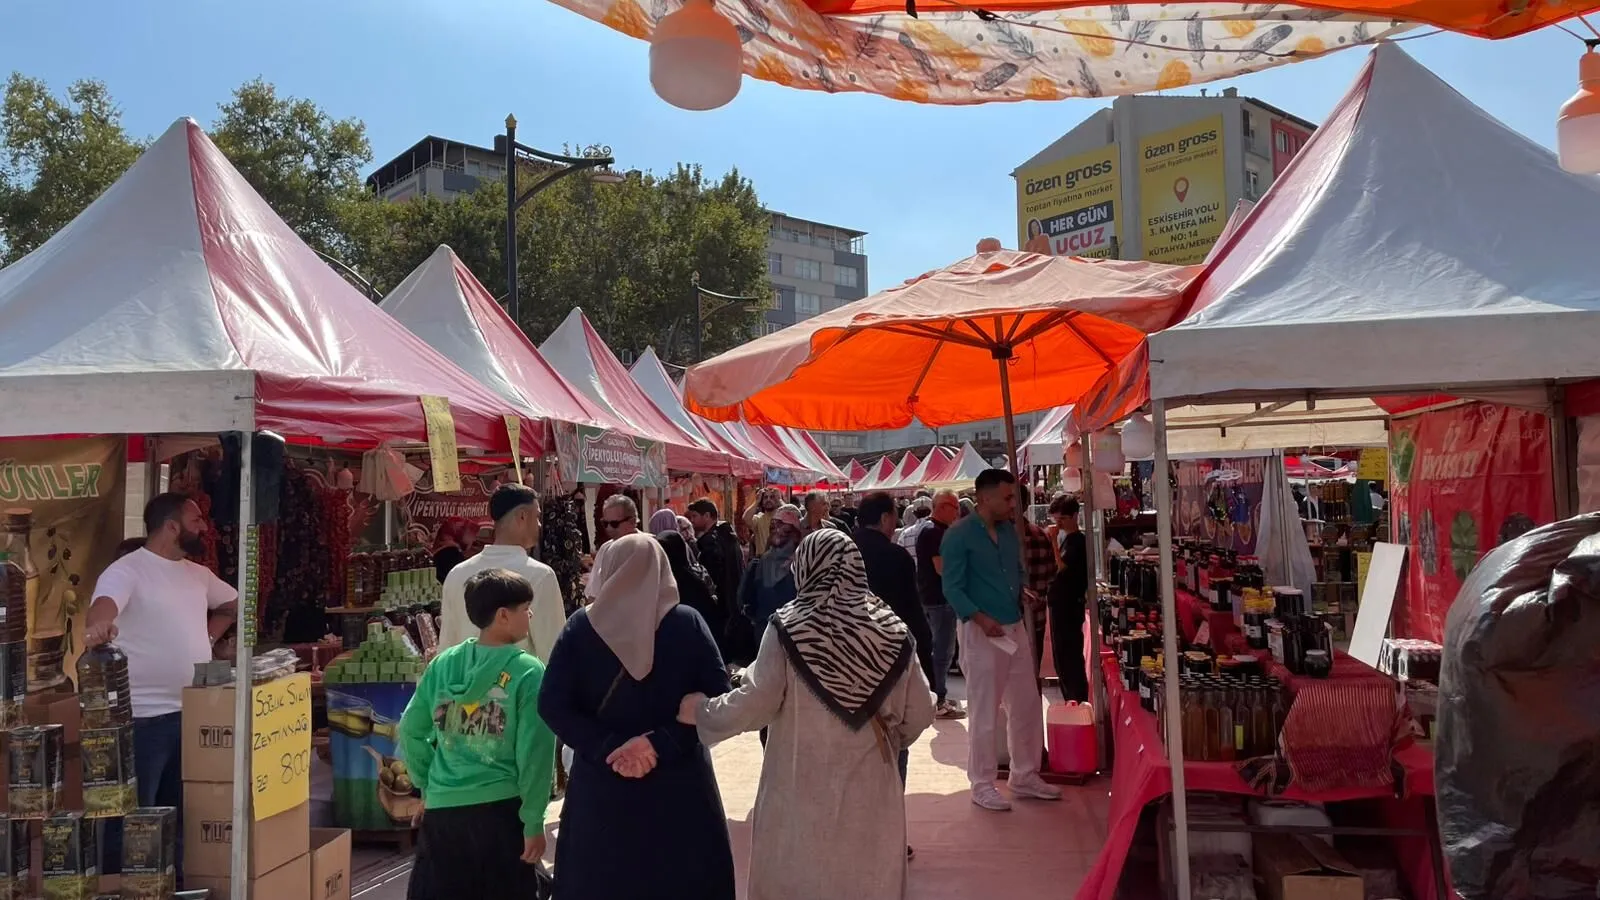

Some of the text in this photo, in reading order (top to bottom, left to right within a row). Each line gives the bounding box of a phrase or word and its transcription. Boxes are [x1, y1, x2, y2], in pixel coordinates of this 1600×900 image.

[1145, 129, 1217, 159] özen gross
[1025, 160, 1113, 195] özen gross
[1026, 201, 1051, 213] toptan
[1084, 184, 1113, 198] market
[1194, 202, 1220, 215] YOLU
[1050, 206, 1108, 234] HER GÜN
[1160, 225, 1174, 234] KM
[1174, 220, 1198, 231] VEFA
[1199, 214, 1217, 225] MH.
[1188, 230, 1198, 238] 14
[1056, 226, 1105, 255] UCUZ
